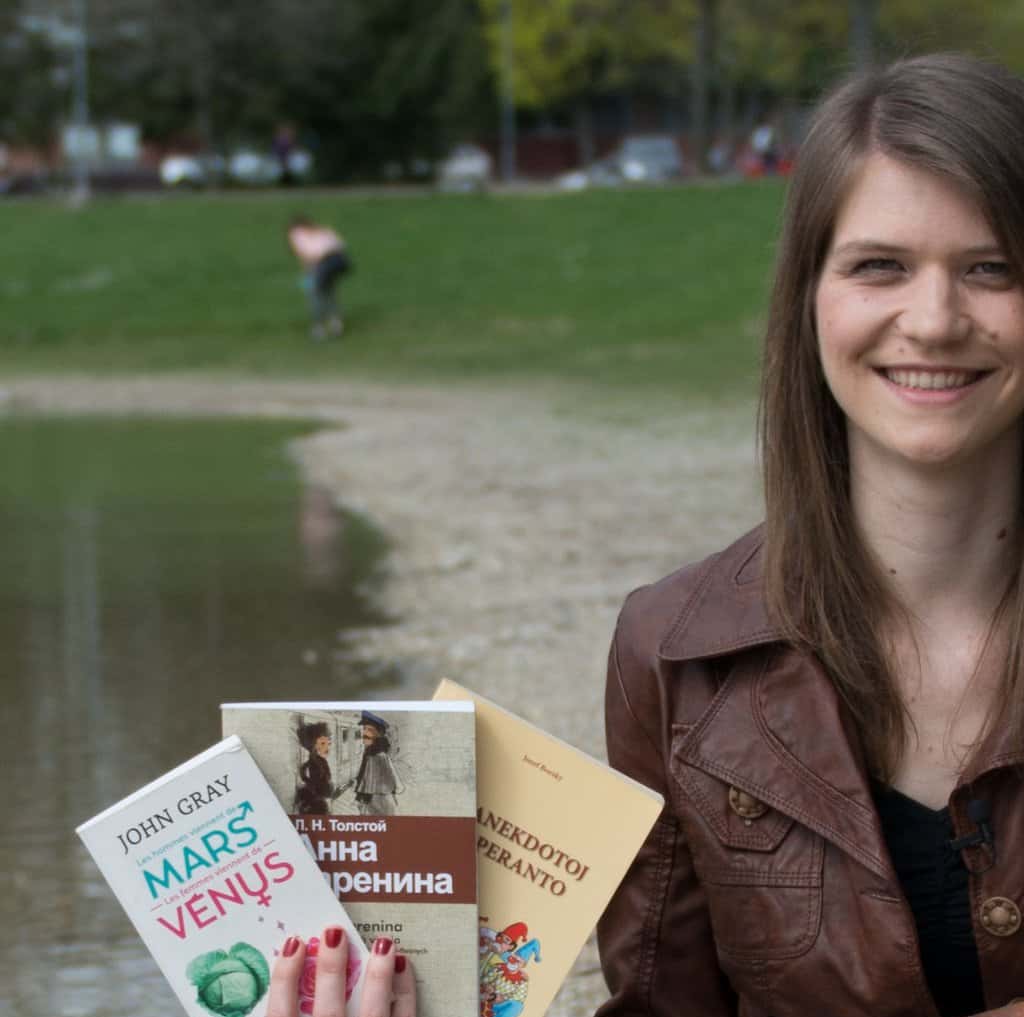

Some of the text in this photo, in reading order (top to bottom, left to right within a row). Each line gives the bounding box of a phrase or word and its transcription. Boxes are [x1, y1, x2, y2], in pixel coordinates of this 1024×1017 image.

[117, 774, 232, 855] JOHN GRAY
[312, 819, 326, 831] Н.
[329, 819, 387, 832] Толстой
[143, 814, 258, 899] MARS
[152, 834, 189, 857] hommes
[180, 873, 214, 897] femmes
[215, 852, 250, 877] viennent
